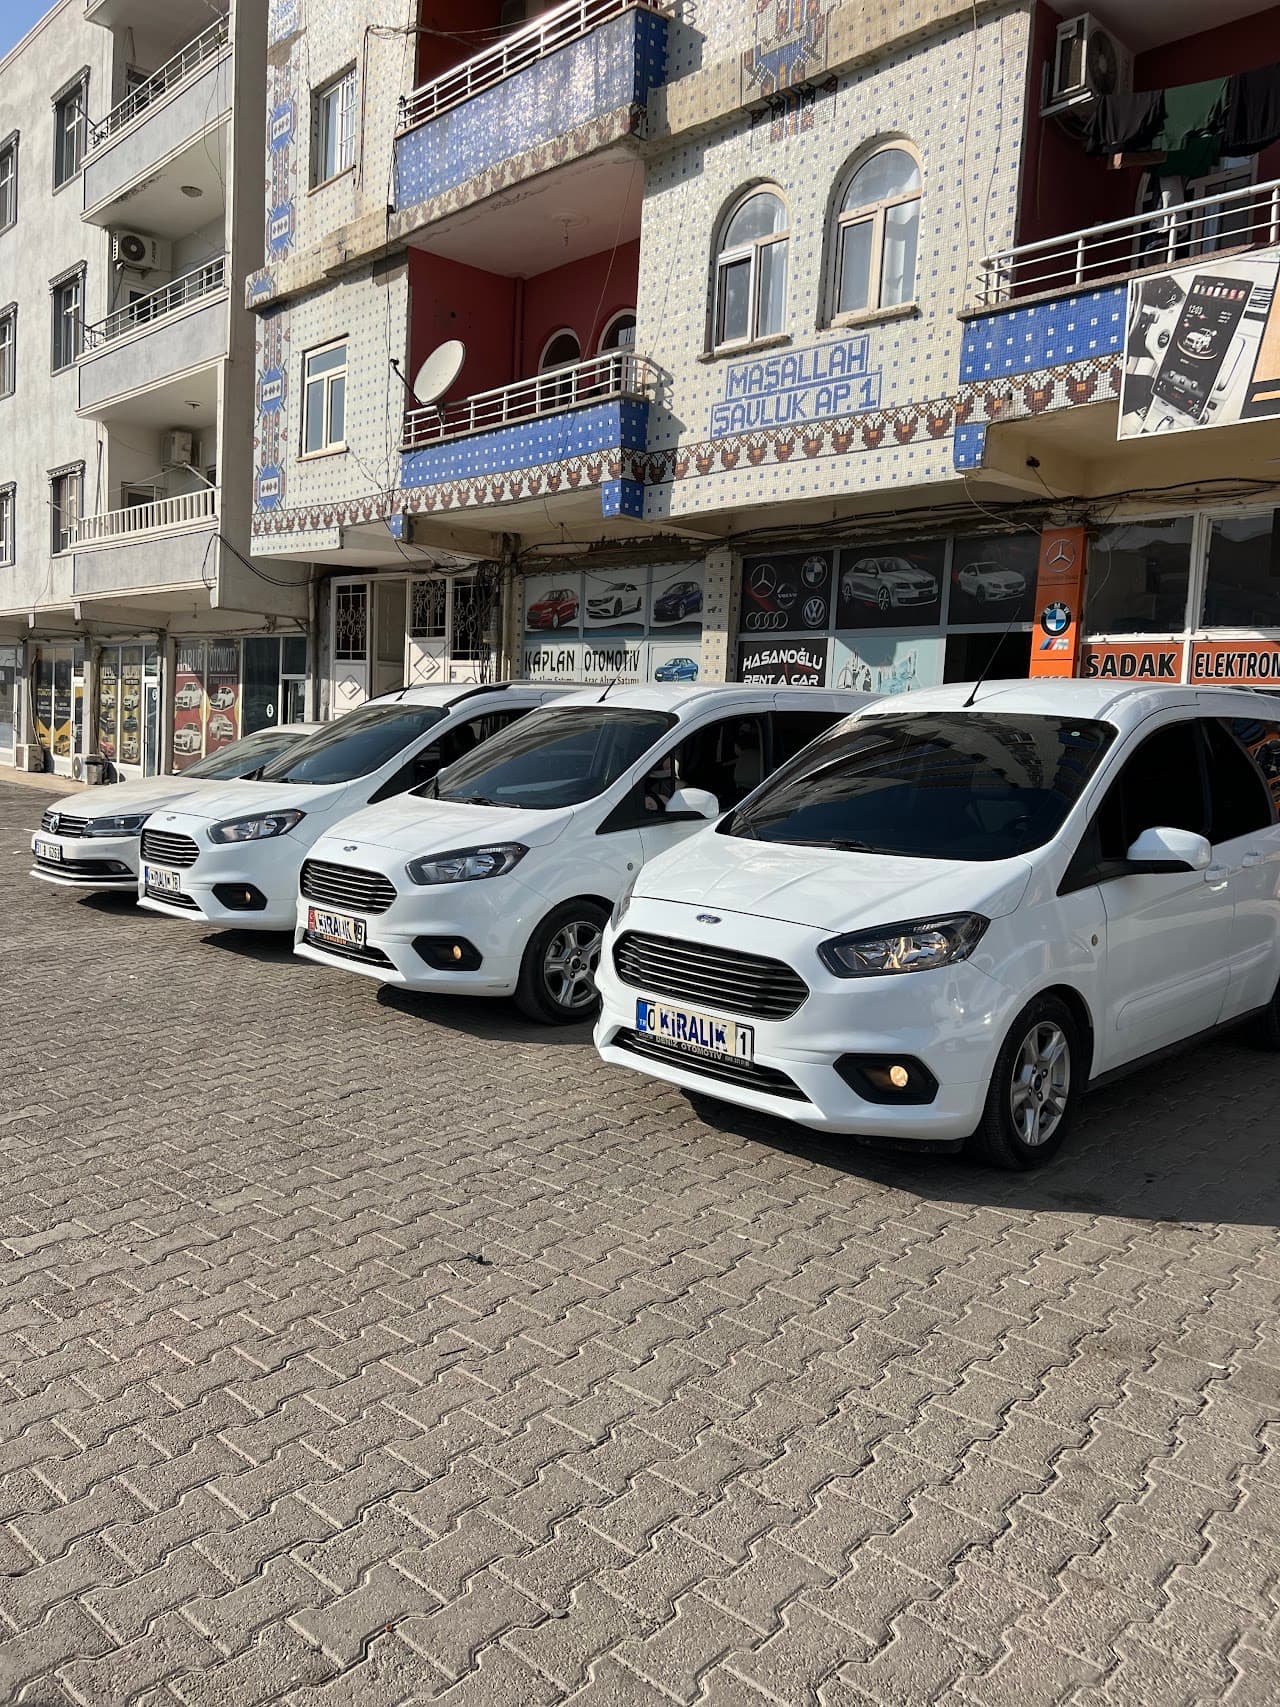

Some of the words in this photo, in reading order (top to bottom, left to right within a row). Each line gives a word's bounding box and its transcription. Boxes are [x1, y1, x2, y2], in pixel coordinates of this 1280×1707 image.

[728, 340, 866, 397] MAŞALLAH
[524, 650, 575, 673] KAPLAN
[742, 648, 823, 672] HASANOĞLU
[1085, 652, 1177, 678] SADAK
[743, 675, 776, 686] RENT
[777, 675, 789, 686] A
[790, 675, 820, 686] CAR
[739, 1031, 746, 1056] 1
